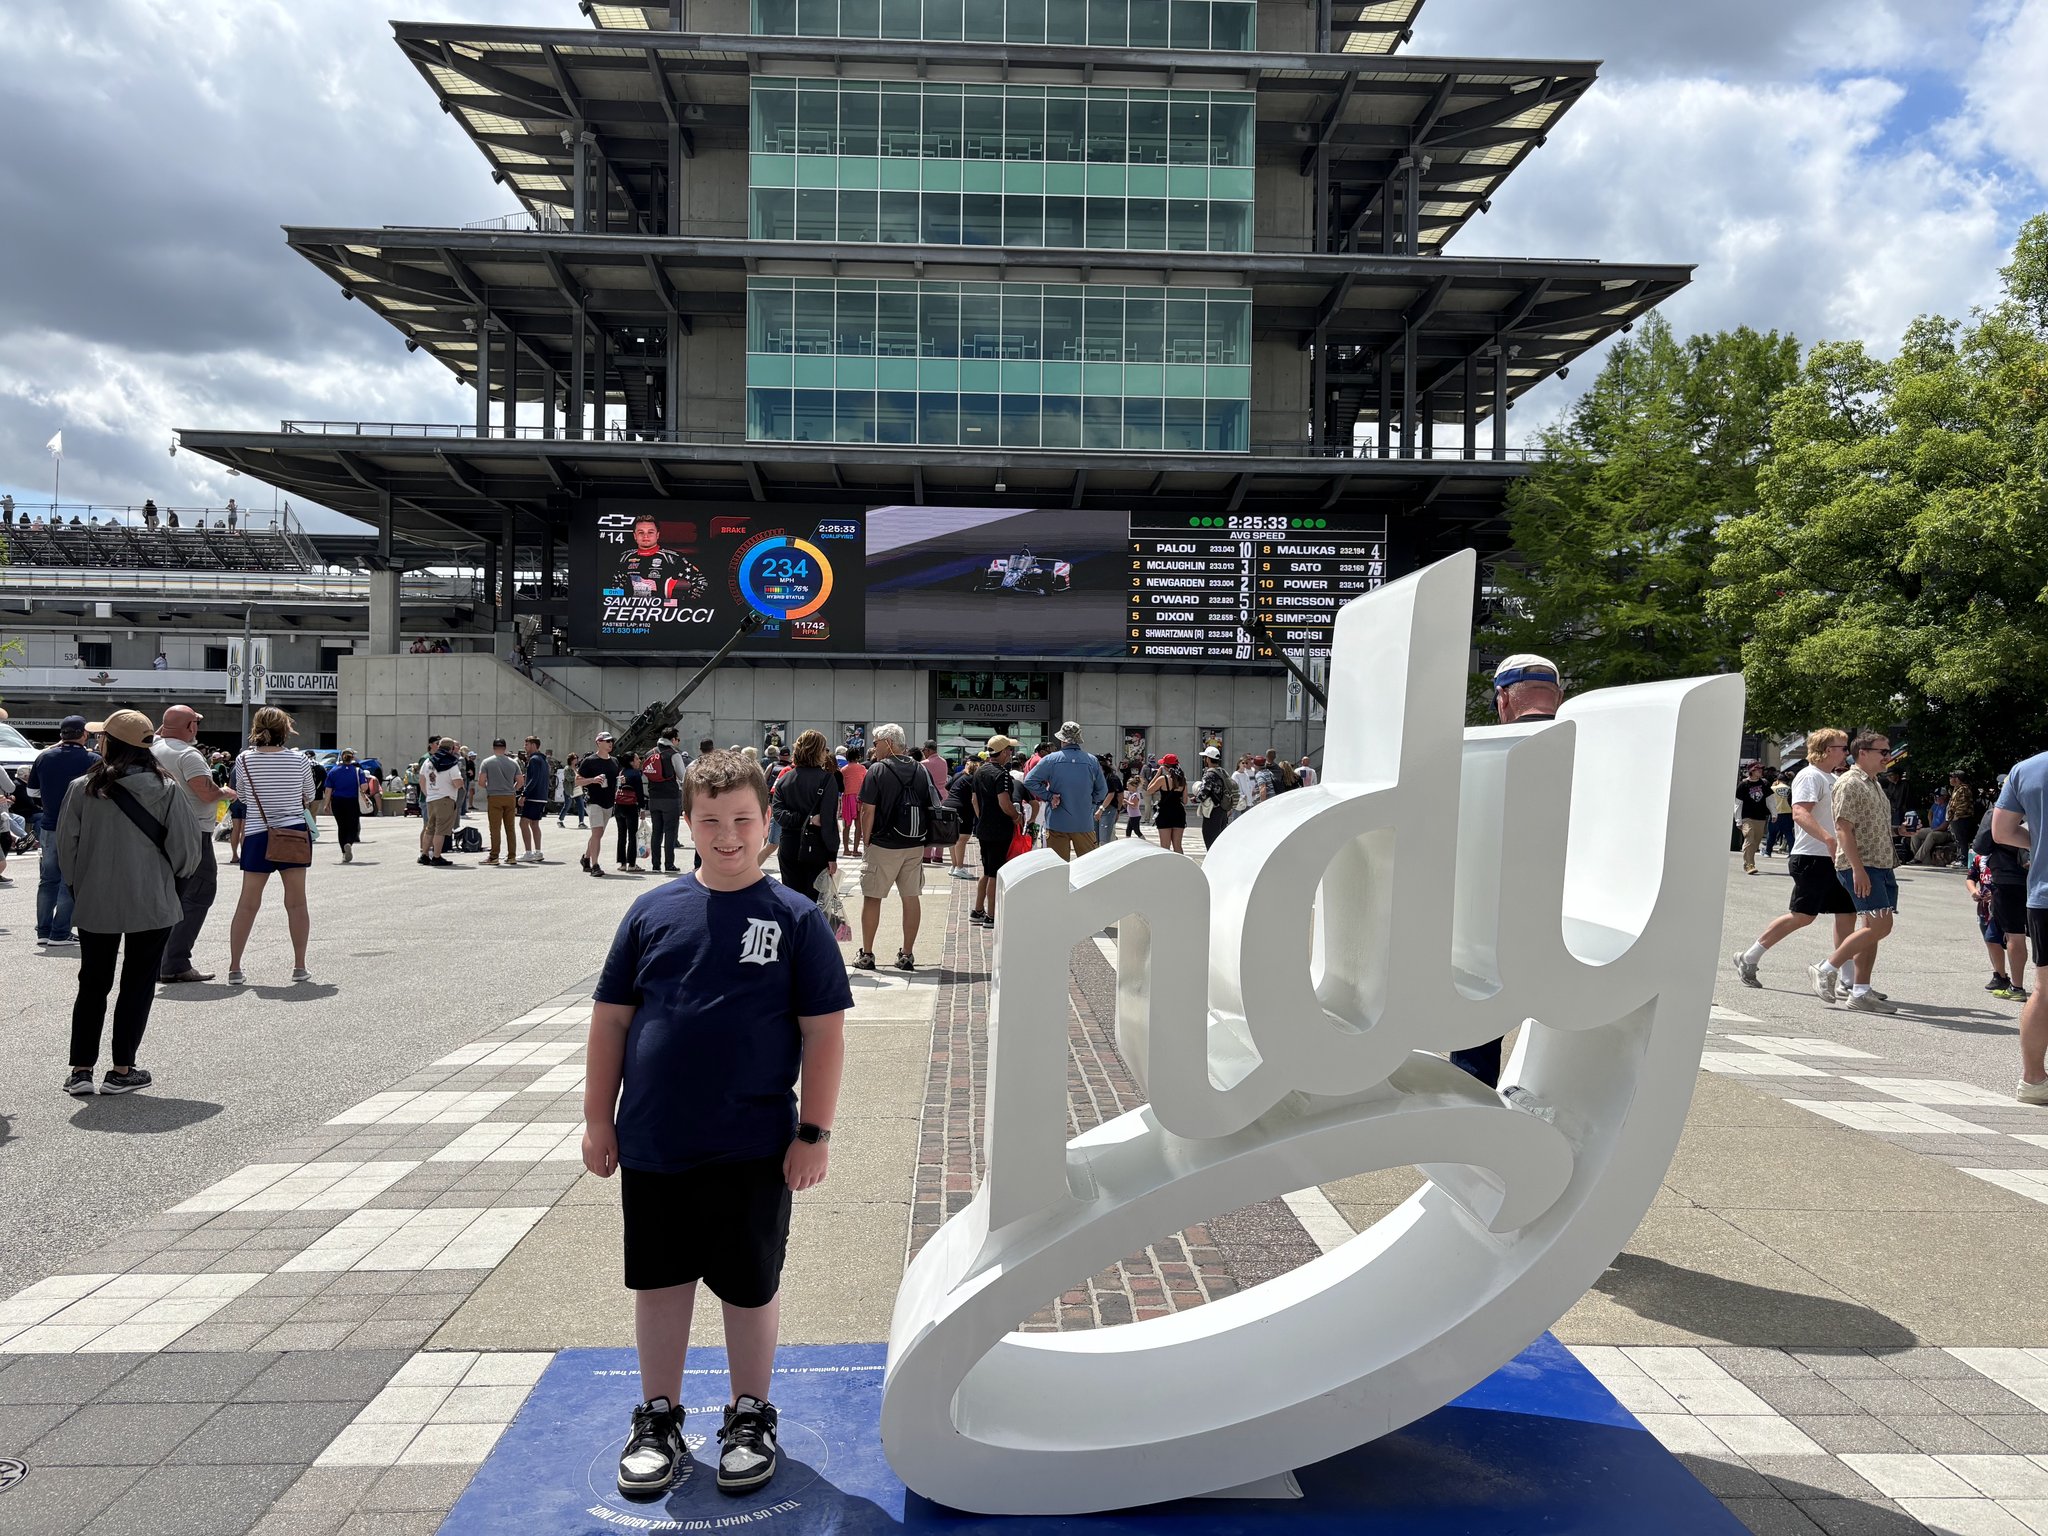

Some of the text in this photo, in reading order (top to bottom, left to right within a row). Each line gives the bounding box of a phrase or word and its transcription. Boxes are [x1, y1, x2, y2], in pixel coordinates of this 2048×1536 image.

[1228, 516, 1288, 530] 2:25:33
[819, 525, 856, 533] 2:25:33
[600, 532, 625, 544] #14
[1230, 532, 1286, 540] AVG SPEED
[1133, 542, 1252, 558] 1 PALOU 233.043 10
[1263, 544, 1380, 560] 8 MALUKAS 232.194 4
[761, 558, 808, 578] 234
[1132, 561, 1140, 569] 2
[1146, 561, 1205, 570] MCLAUGHLIN
[1241, 559, 1249, 574] 3
[1262, 562, 1271, 571] 9
[1290, 563, 1322, 572] SATO
[1367, 562, 1383, 576] 75
[1132, 578, 1140, 586] 3
[1146, 578, 1205, 587] NEWGARDEN
[1240, 577, 1249, 592] 2
[1259, 579, 1274, 588] 10
[1283, 580, 1328, 589] POWER
[1339, 581, 1365, 589] 232.144
[603, 596, 662, 607] SANTINO
[1132, 595, 1140, 603] 4
[1151, 595, 1200, 604] O'WARD
[1239, 593, 1249, 609] 5
[1259, 596, 1272, 605] 11
[1276, 596, 1335, 606] ERICSSON
[603, 607, 715, 623] FERRUCCI
[1132, 612, 1140, 620] 5
[1156, 612, 1194, 621] DIXON
[1258, 613, 1273, 622] 12
[794, 622, 825, 630] 11742
[1131, 629, 1140, 637] 6
[1145, 629, 1193, 638] SHWARTZMAN
[1194, 629, 1204, 640] (R)
[1286, 631, 1323, 640] ROSSI
[64, 653, 78, 661] 534
[1131, 646, 1139, 655] 7
[1145, 646, 1204, 655] ROSENQVIST
[1235, 645, 1252, 659] 60
[1258, 647, 1273, 656] 14
[266, 674, 295, 688] ACING
[968, 703, 1036, 713] PAGODA SUITES
[701, 1405, 721, 1413] NOT
[586, 1499, 802, 1530] TELL US WHAT YOU LOVE ABOUT INDY.
